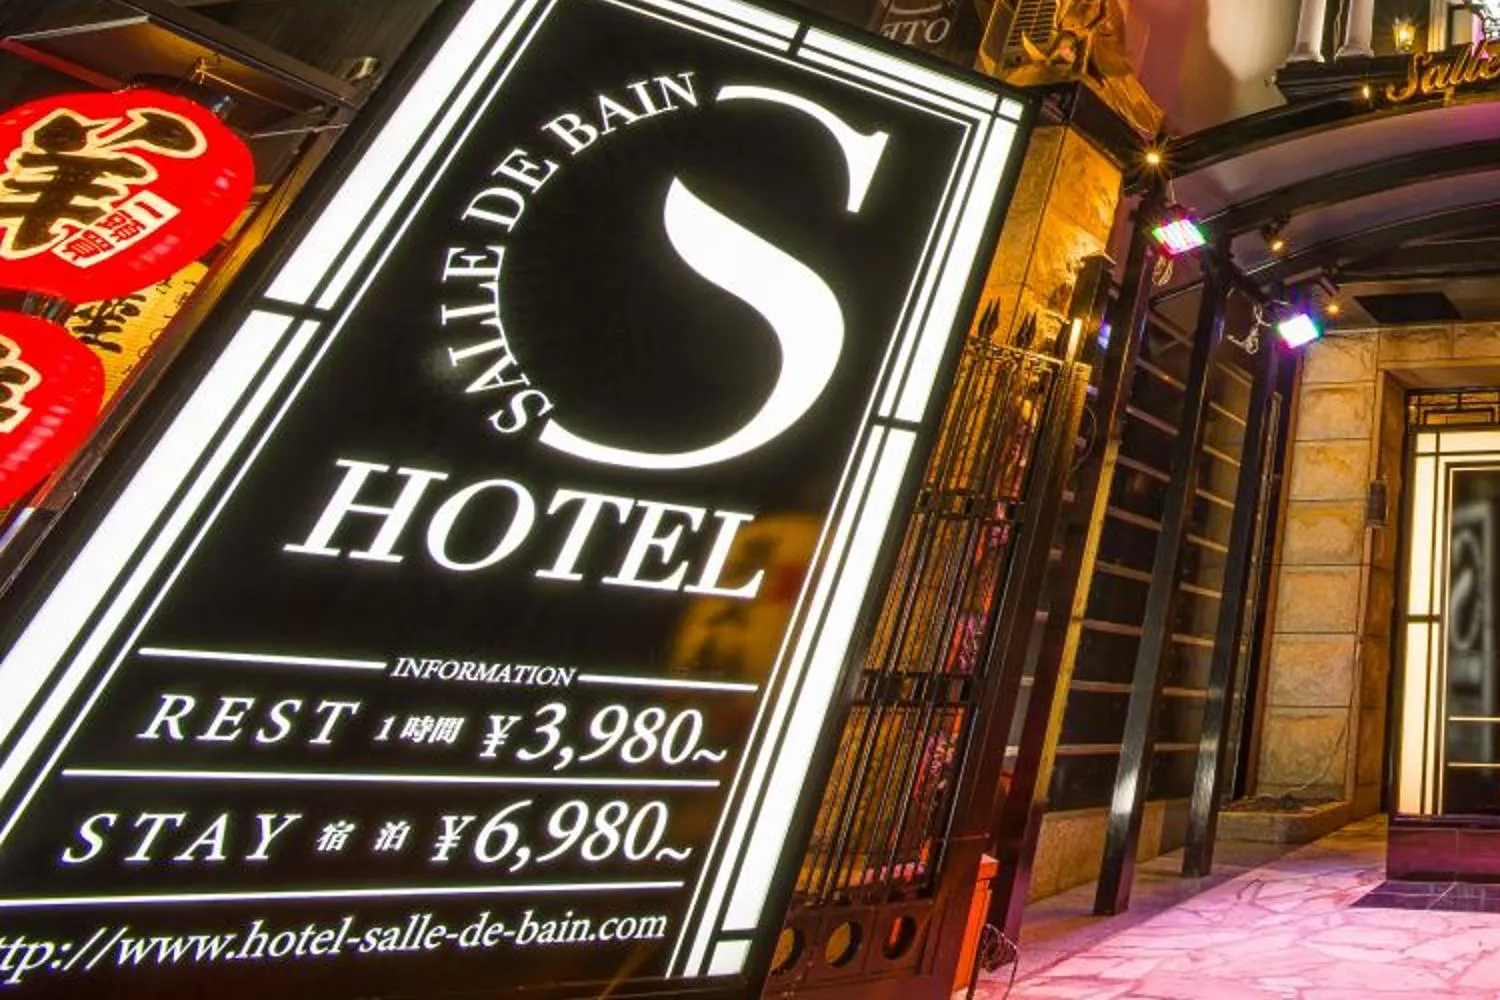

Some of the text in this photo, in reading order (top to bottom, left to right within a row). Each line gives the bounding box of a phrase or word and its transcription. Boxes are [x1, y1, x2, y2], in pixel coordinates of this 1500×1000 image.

[441, 70, 699, 434] SALLE DE BAIN
[284, 460, 766, 600] HOTEL
[390, 656, 578, 689] INFORMATION
[136, 694, 362, 746] REST
[59, 813, 303, 864] STAY
